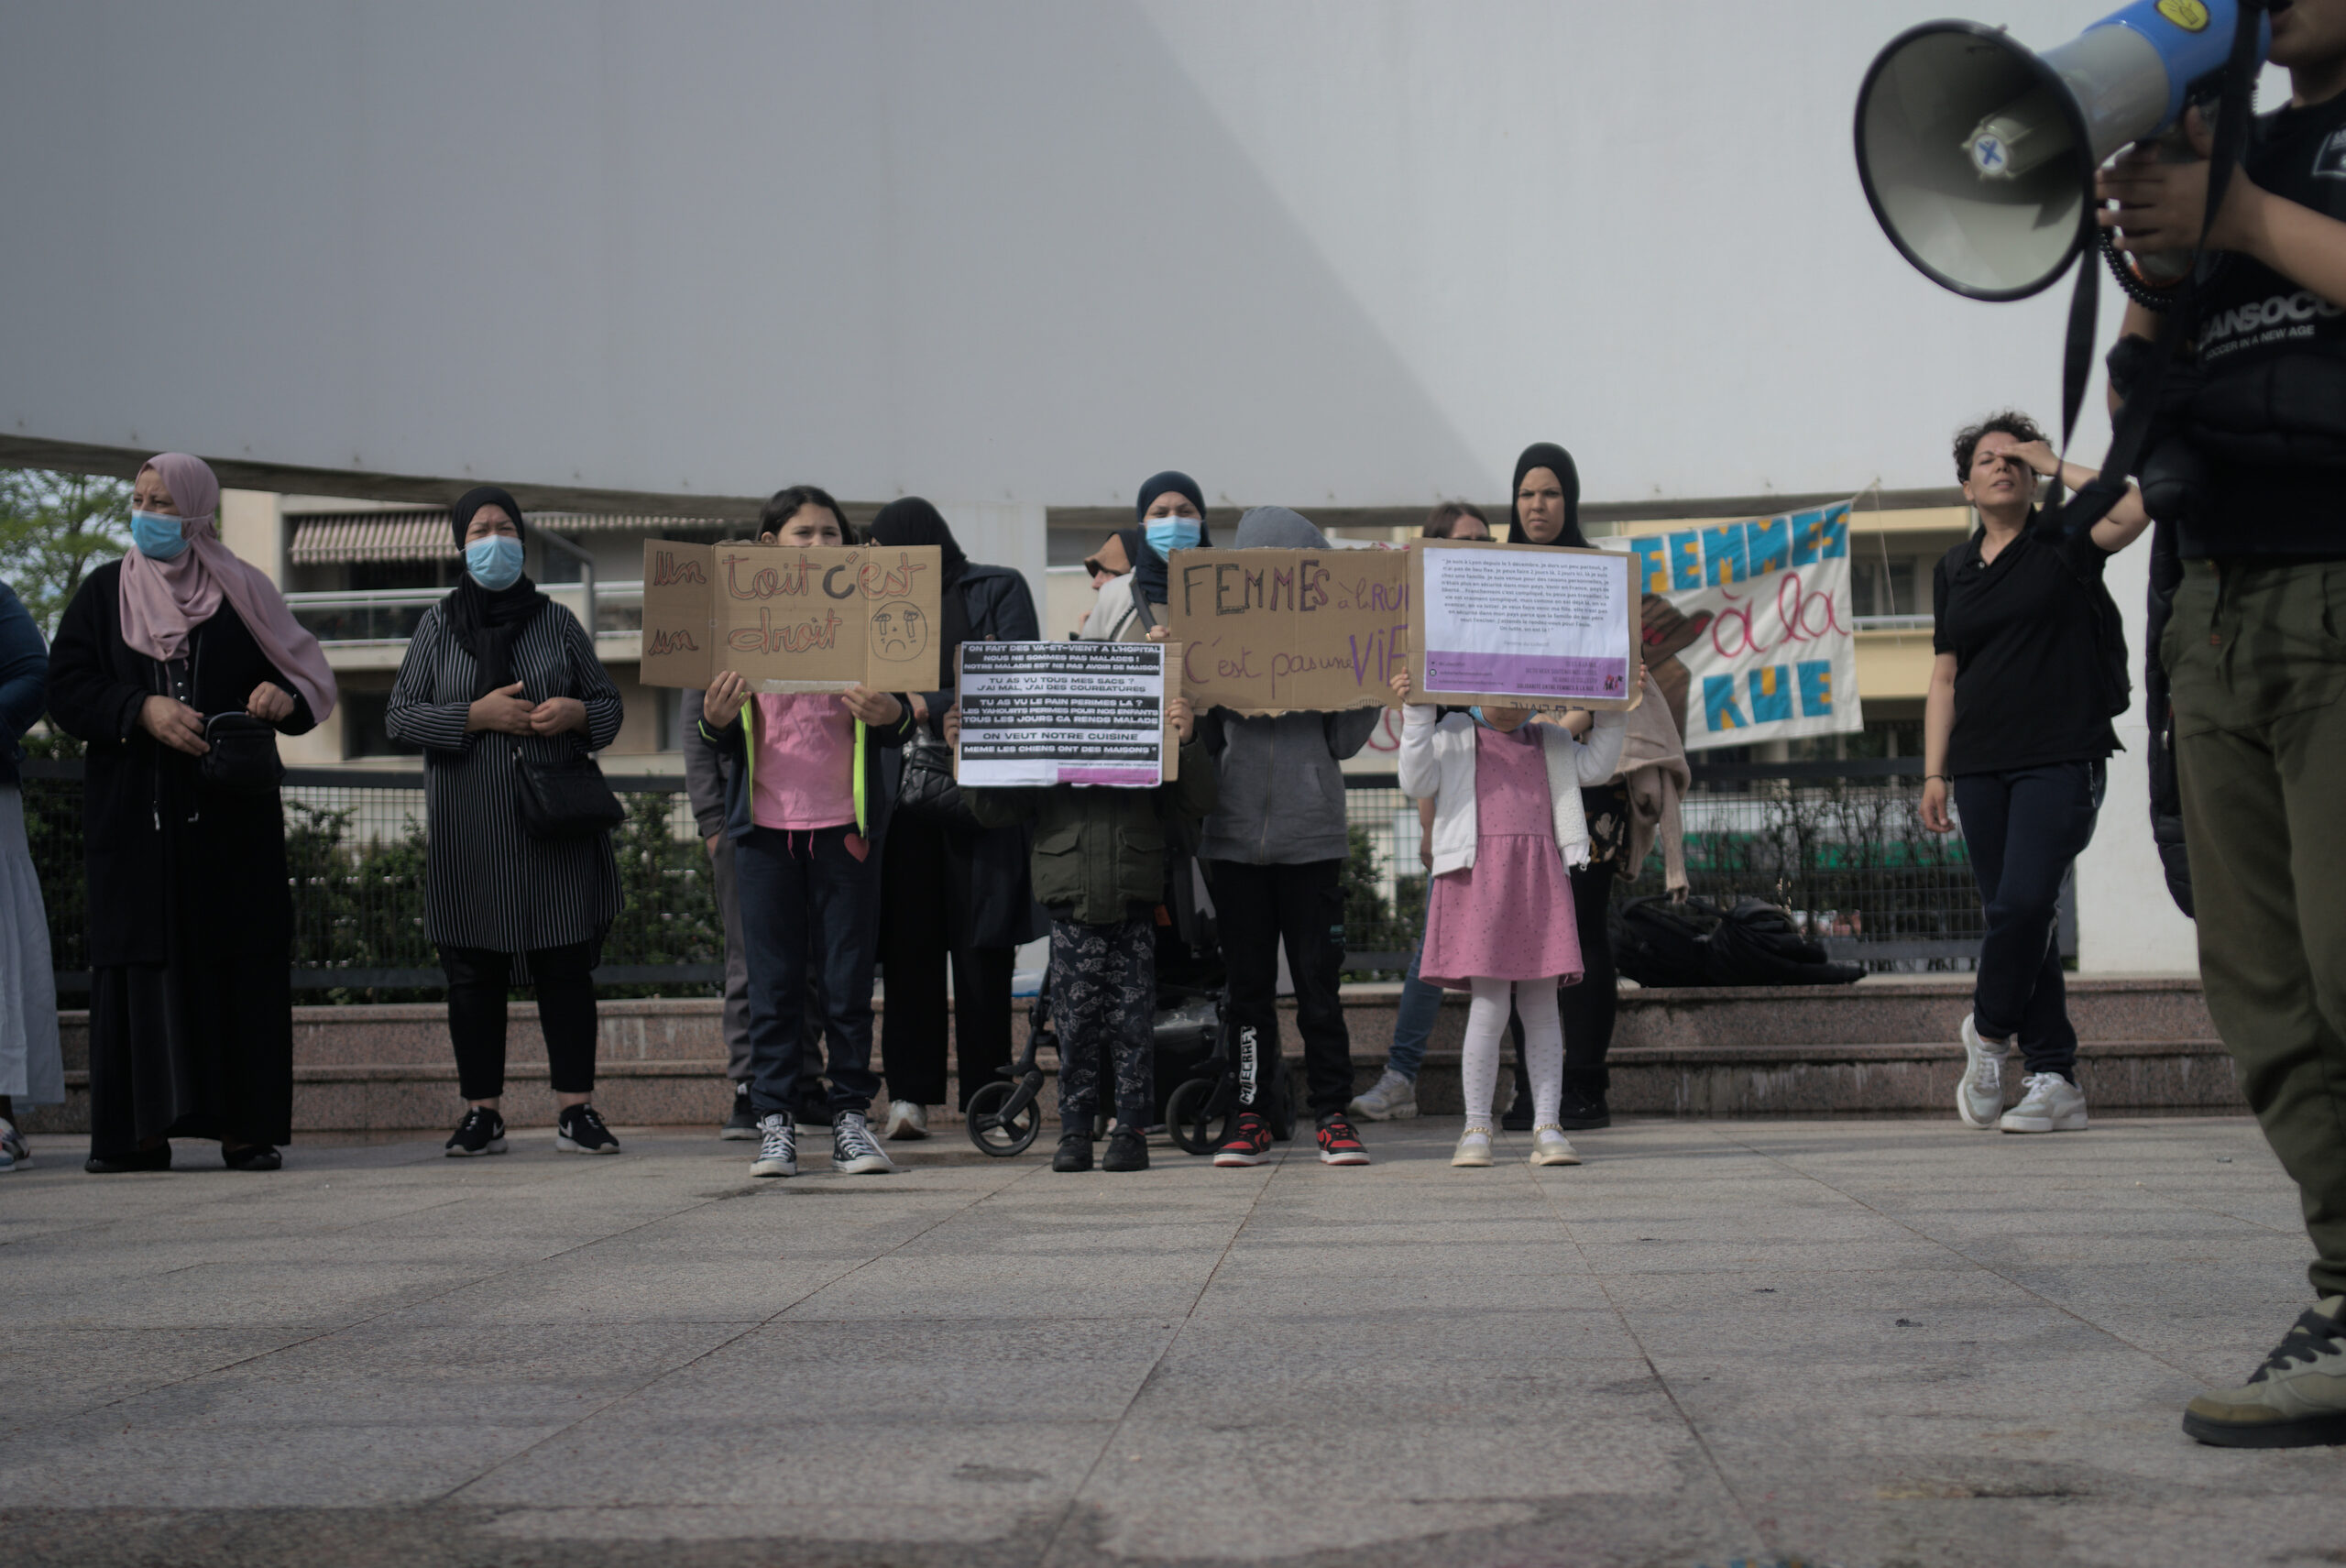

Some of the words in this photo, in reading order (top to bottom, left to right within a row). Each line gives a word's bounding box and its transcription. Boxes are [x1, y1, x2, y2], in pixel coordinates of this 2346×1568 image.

[2206, 340, 2238, 361] SOCCER
[2239, 337, 2250, 347] IN
[2252, 335, 2259, 345] A
[2260, 328, 2286, 342] NEW
[2288, 324, 2316, 337] AGE
[1631, 503, 1850, 595] FEMMES
[1184, 559, 1330, 616] FEMMES
[1712, 587, 1769, 658] à
[1779, 571, 1850, 644] la
[728, 606, 842, 654] droit
[1703, 660, 1834, 732] RUE
